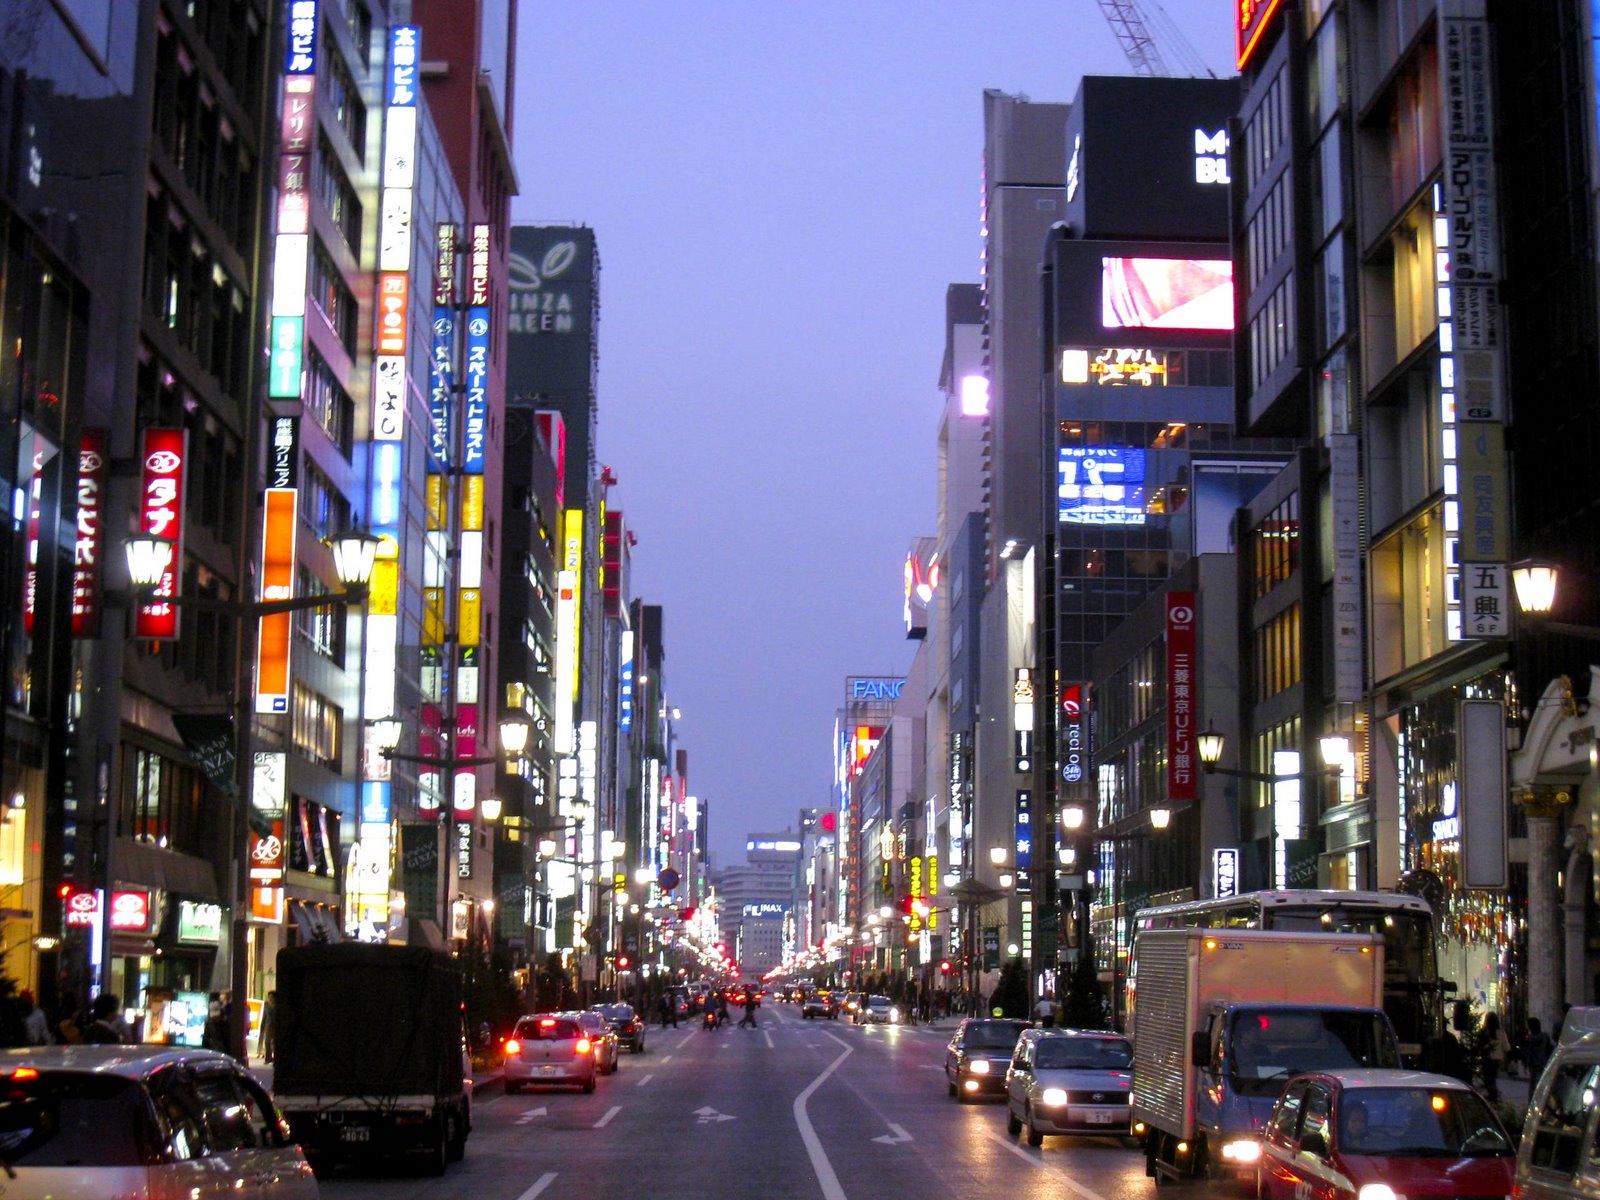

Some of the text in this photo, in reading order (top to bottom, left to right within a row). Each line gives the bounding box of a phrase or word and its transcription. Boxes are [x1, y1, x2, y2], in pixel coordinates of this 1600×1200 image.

[1194, 128, 1230, 154] M
[511, 292, 572, 311] INZA
[509, 313, 573, 332] REEN
[1174, 653, 1191, 785] 三菱東京UFJ銀行
